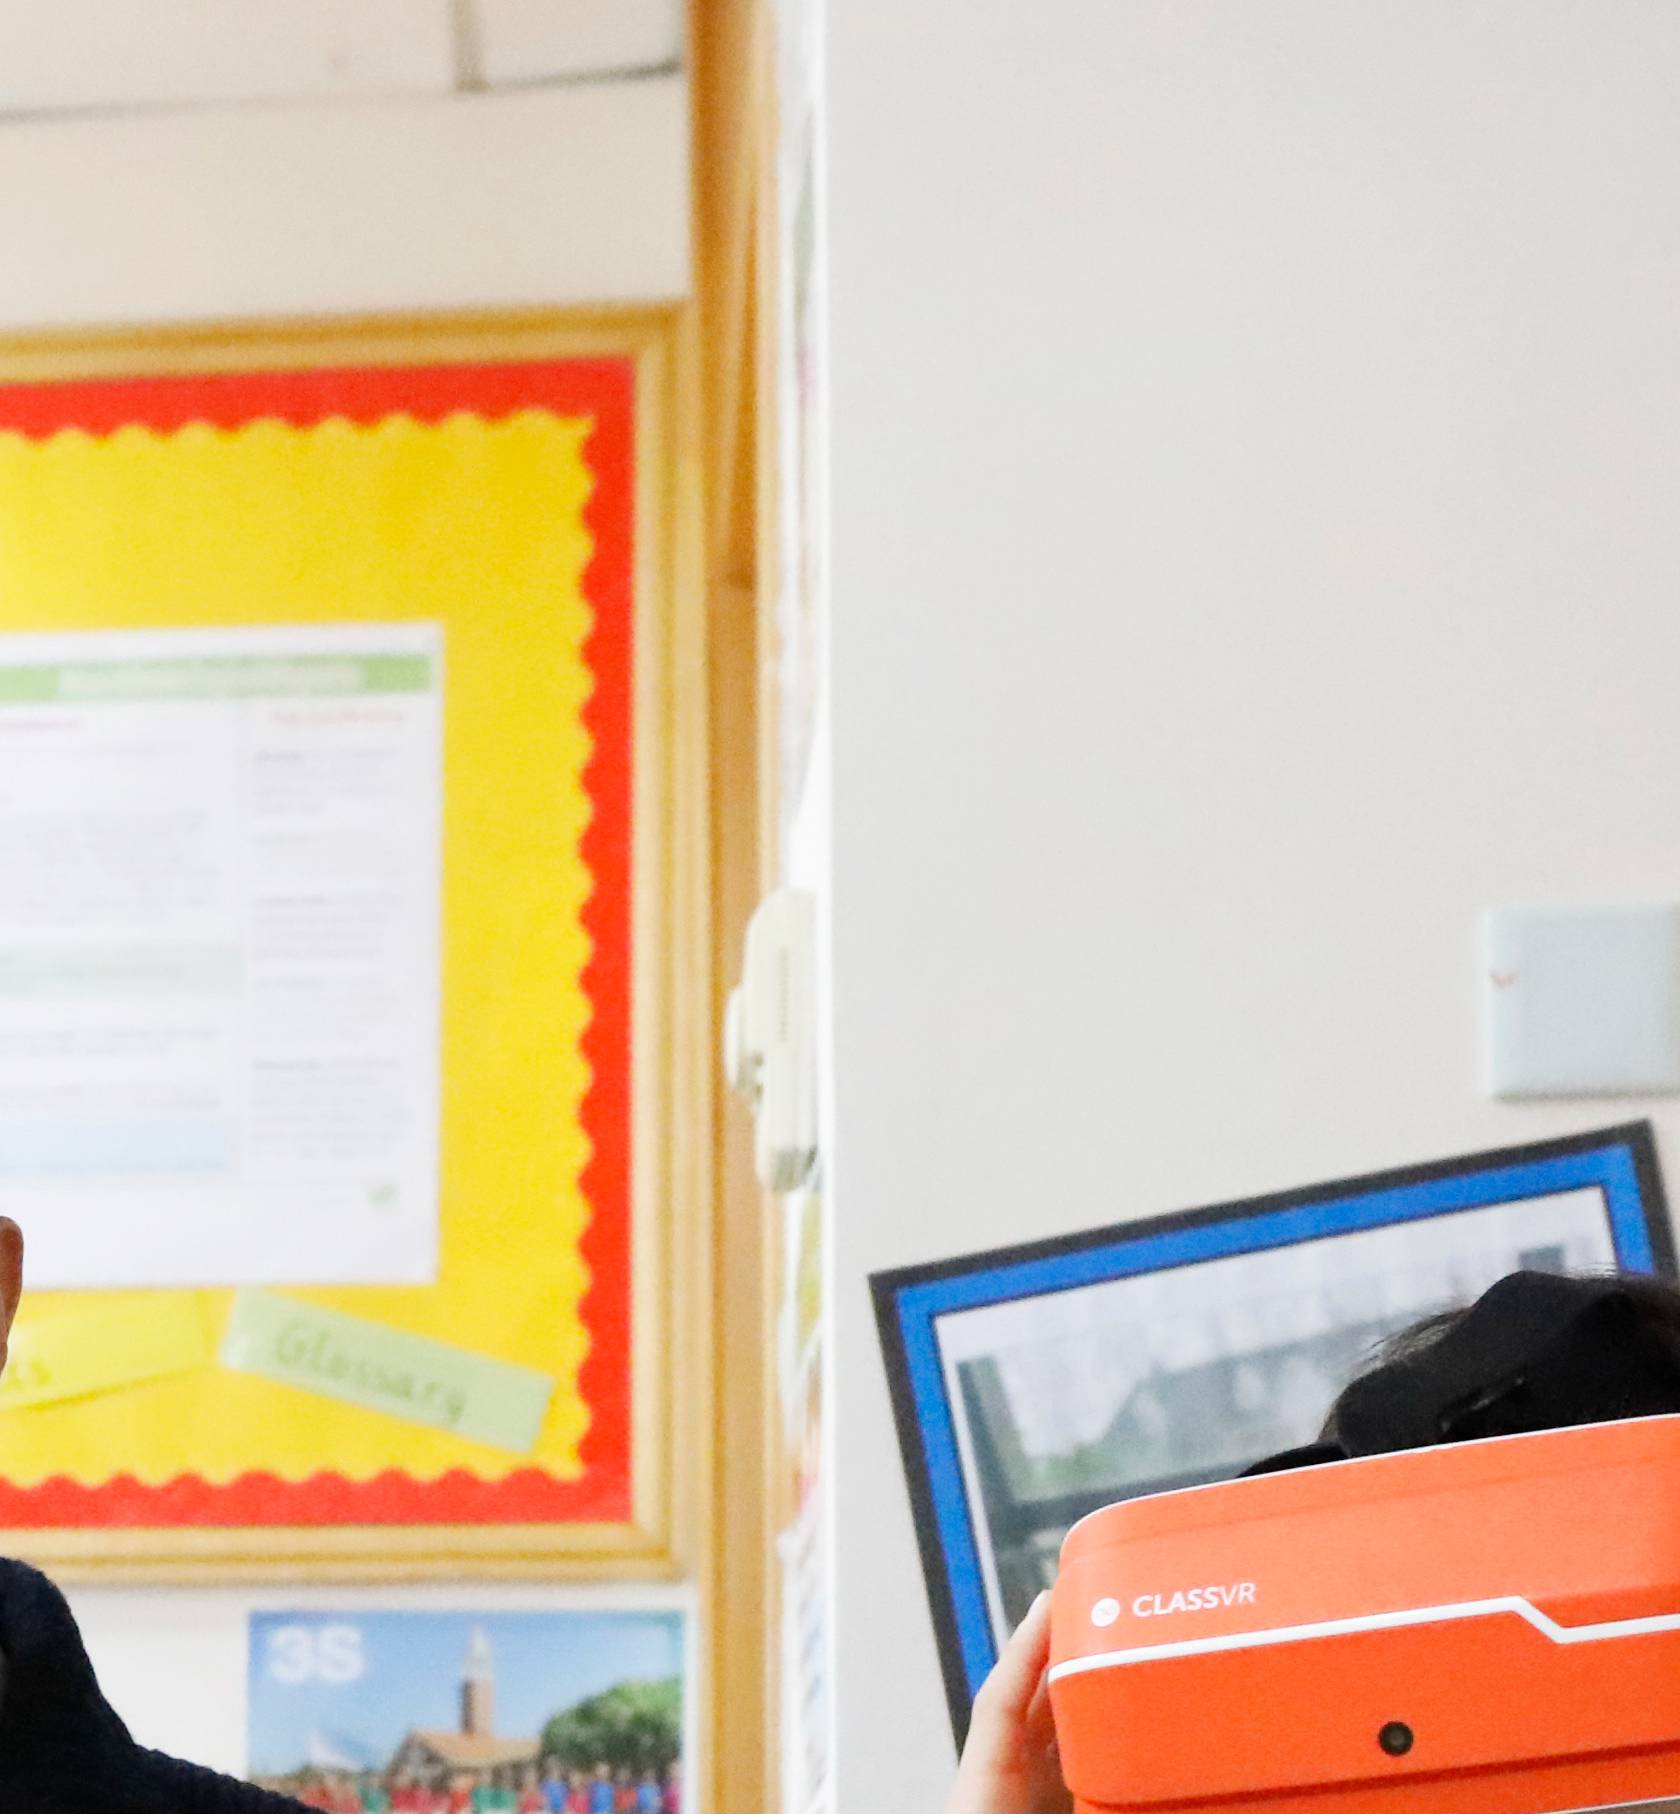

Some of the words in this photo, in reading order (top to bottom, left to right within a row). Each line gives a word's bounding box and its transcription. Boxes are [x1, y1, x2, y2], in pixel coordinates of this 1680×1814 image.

[273, 1316, 469, 1430] Glossary
[1132, 1582, 1257, 1618] CLASSVR
[266, 1625, 366, 1684] 3S
